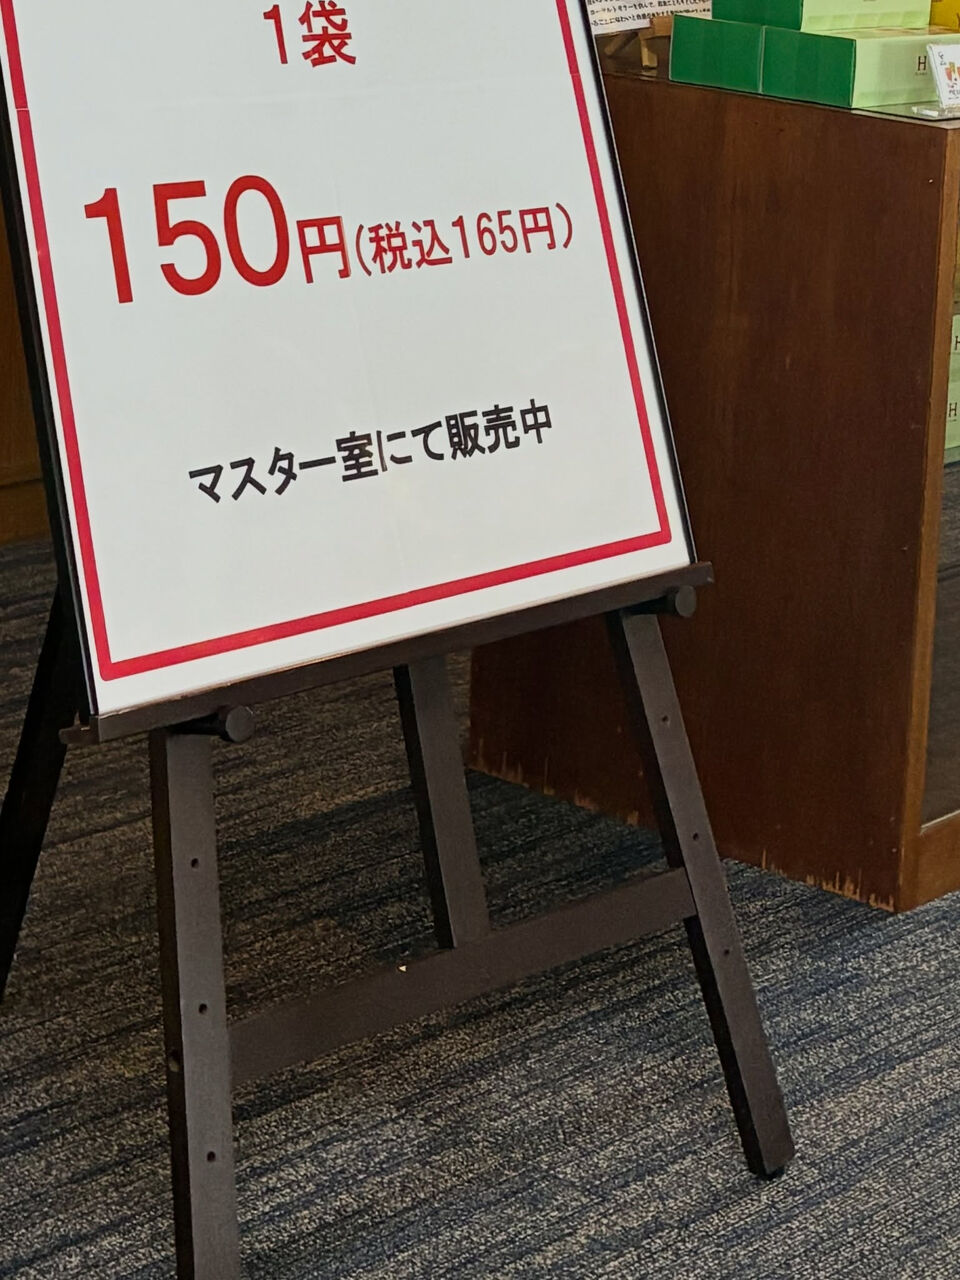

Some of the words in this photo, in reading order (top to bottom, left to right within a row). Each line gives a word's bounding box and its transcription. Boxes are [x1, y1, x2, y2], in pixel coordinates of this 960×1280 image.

[263, 0, 358, 68] 1袋
[83, 174, 576, 304] 150円(税込165円)
[188, 398, 554, 504] マスター室にて販売中
